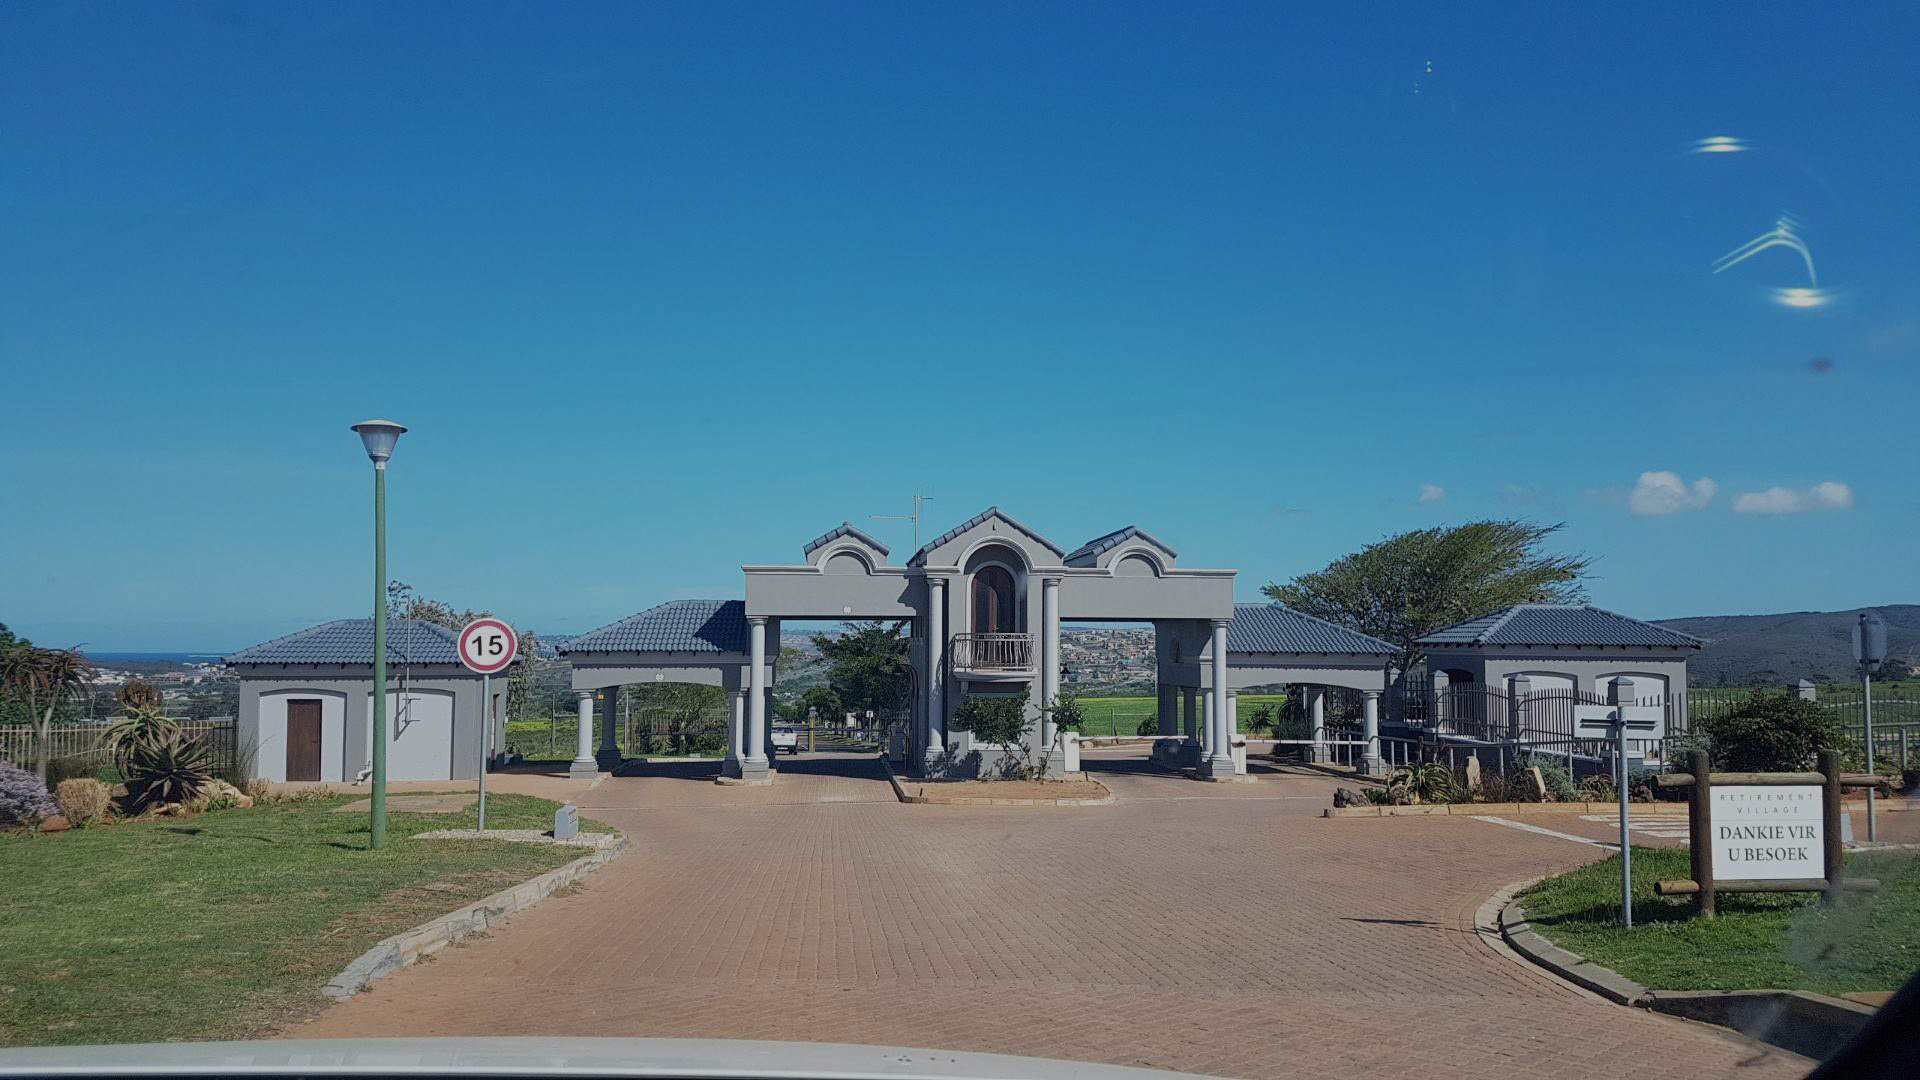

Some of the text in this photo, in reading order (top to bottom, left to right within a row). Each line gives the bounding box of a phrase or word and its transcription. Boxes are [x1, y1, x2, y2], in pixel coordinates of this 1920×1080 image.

[472, 635, 503, 656] 15
[1720, 793, 1813, 801] RETIREMENT
[1737, 806, 1799, 814] VILLAGE
[1720, 826, 1816, 839] DANKIE VIR
[1728, 847, 1808, 861] U BESOEK
